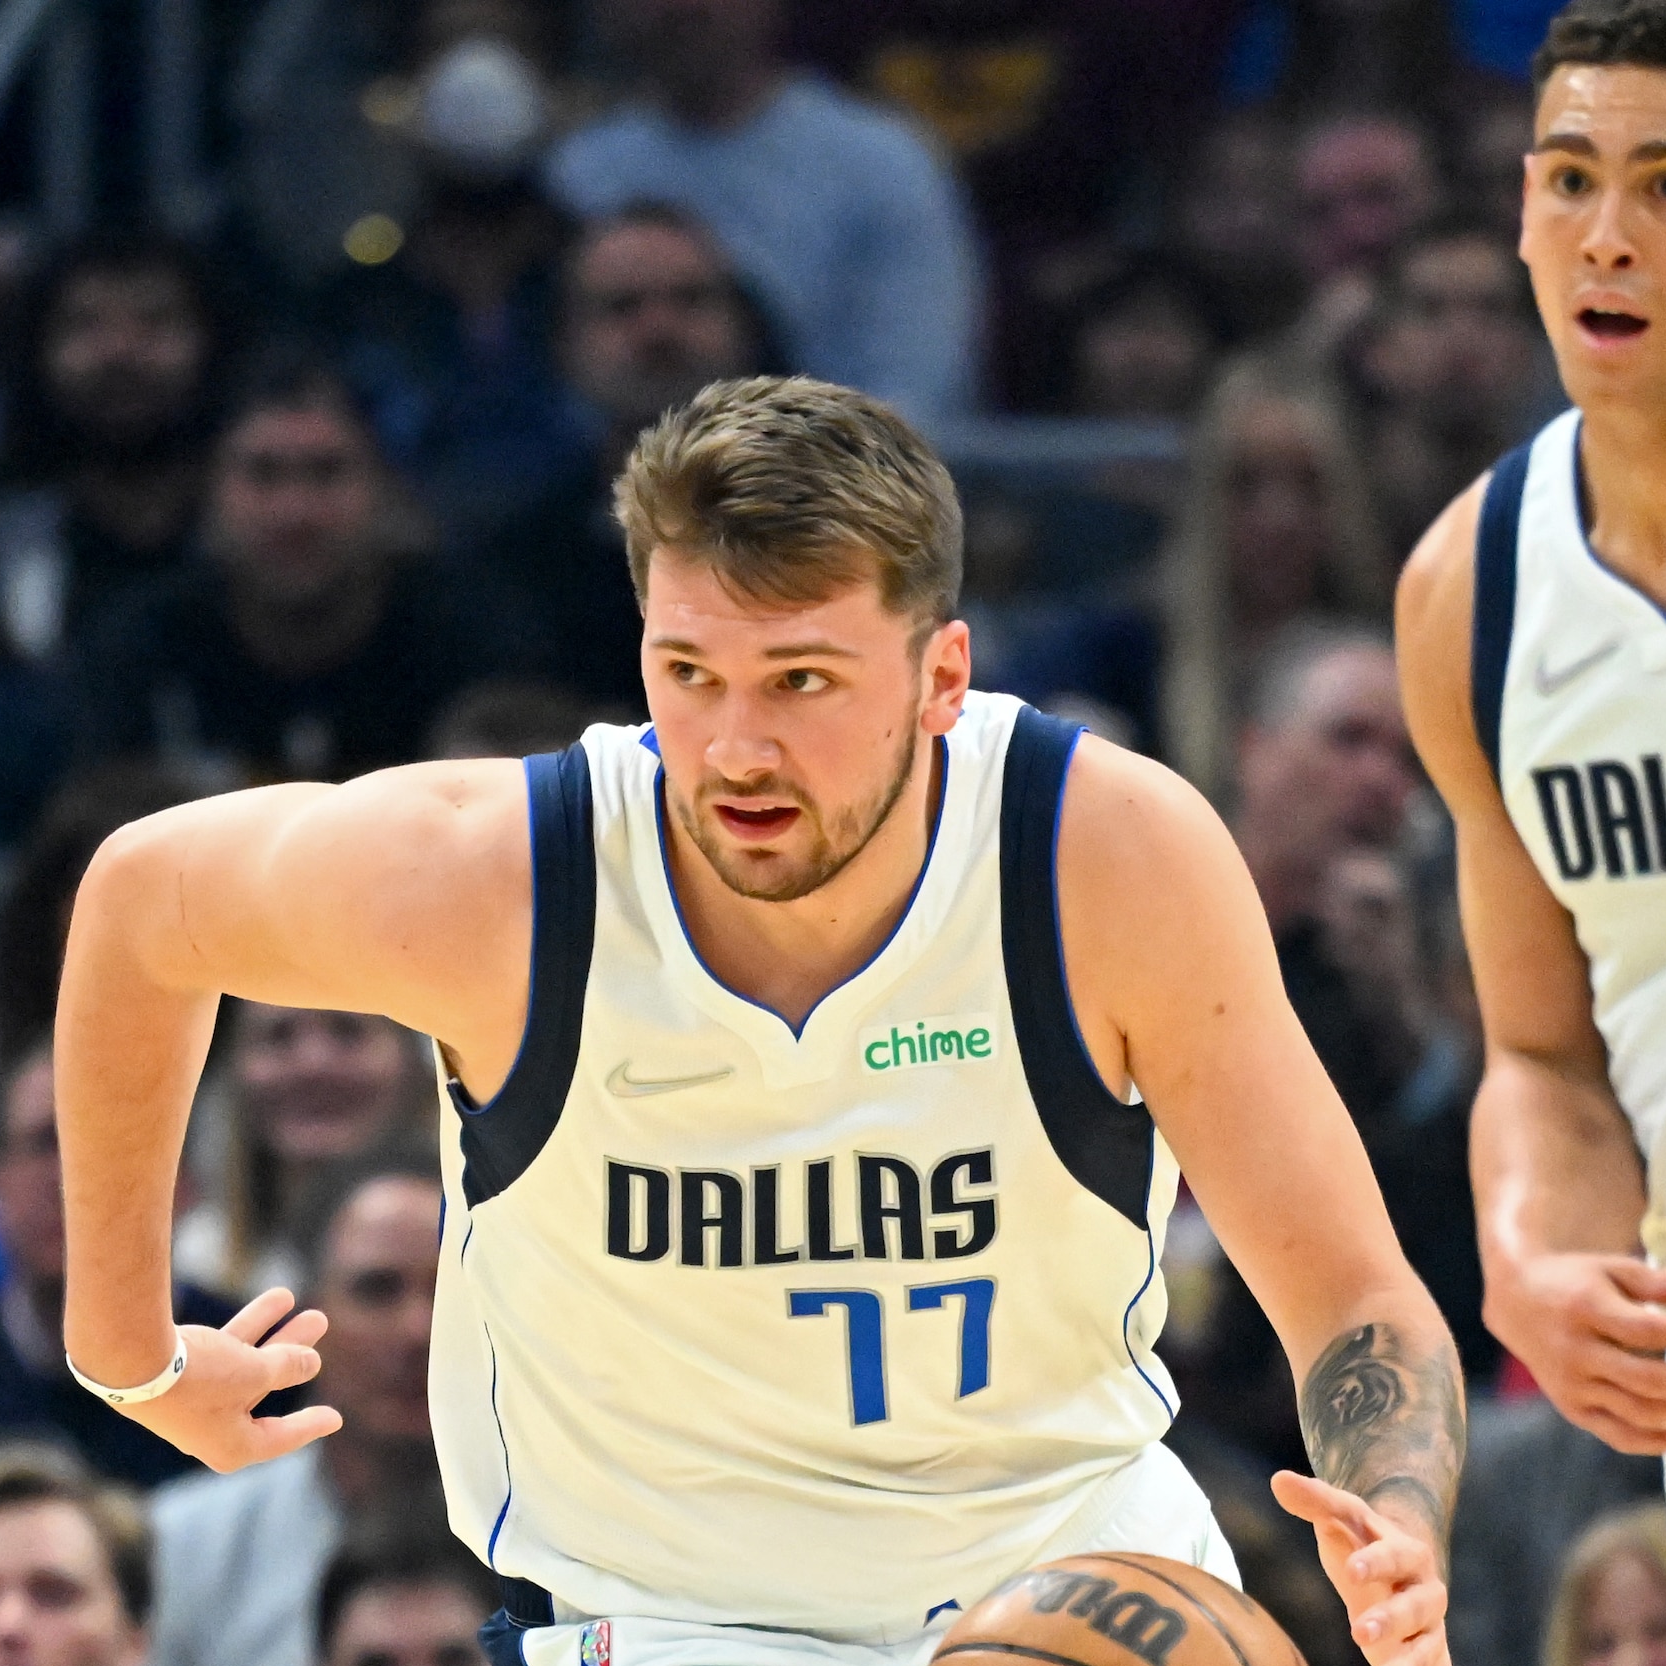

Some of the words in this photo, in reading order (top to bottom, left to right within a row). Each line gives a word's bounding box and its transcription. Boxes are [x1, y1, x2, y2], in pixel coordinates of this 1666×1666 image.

[863, 1021, 994, 1073] chime
[603, 1144, 998, 1270] DALLAS
[785, 1274, 999, 1429] 77
